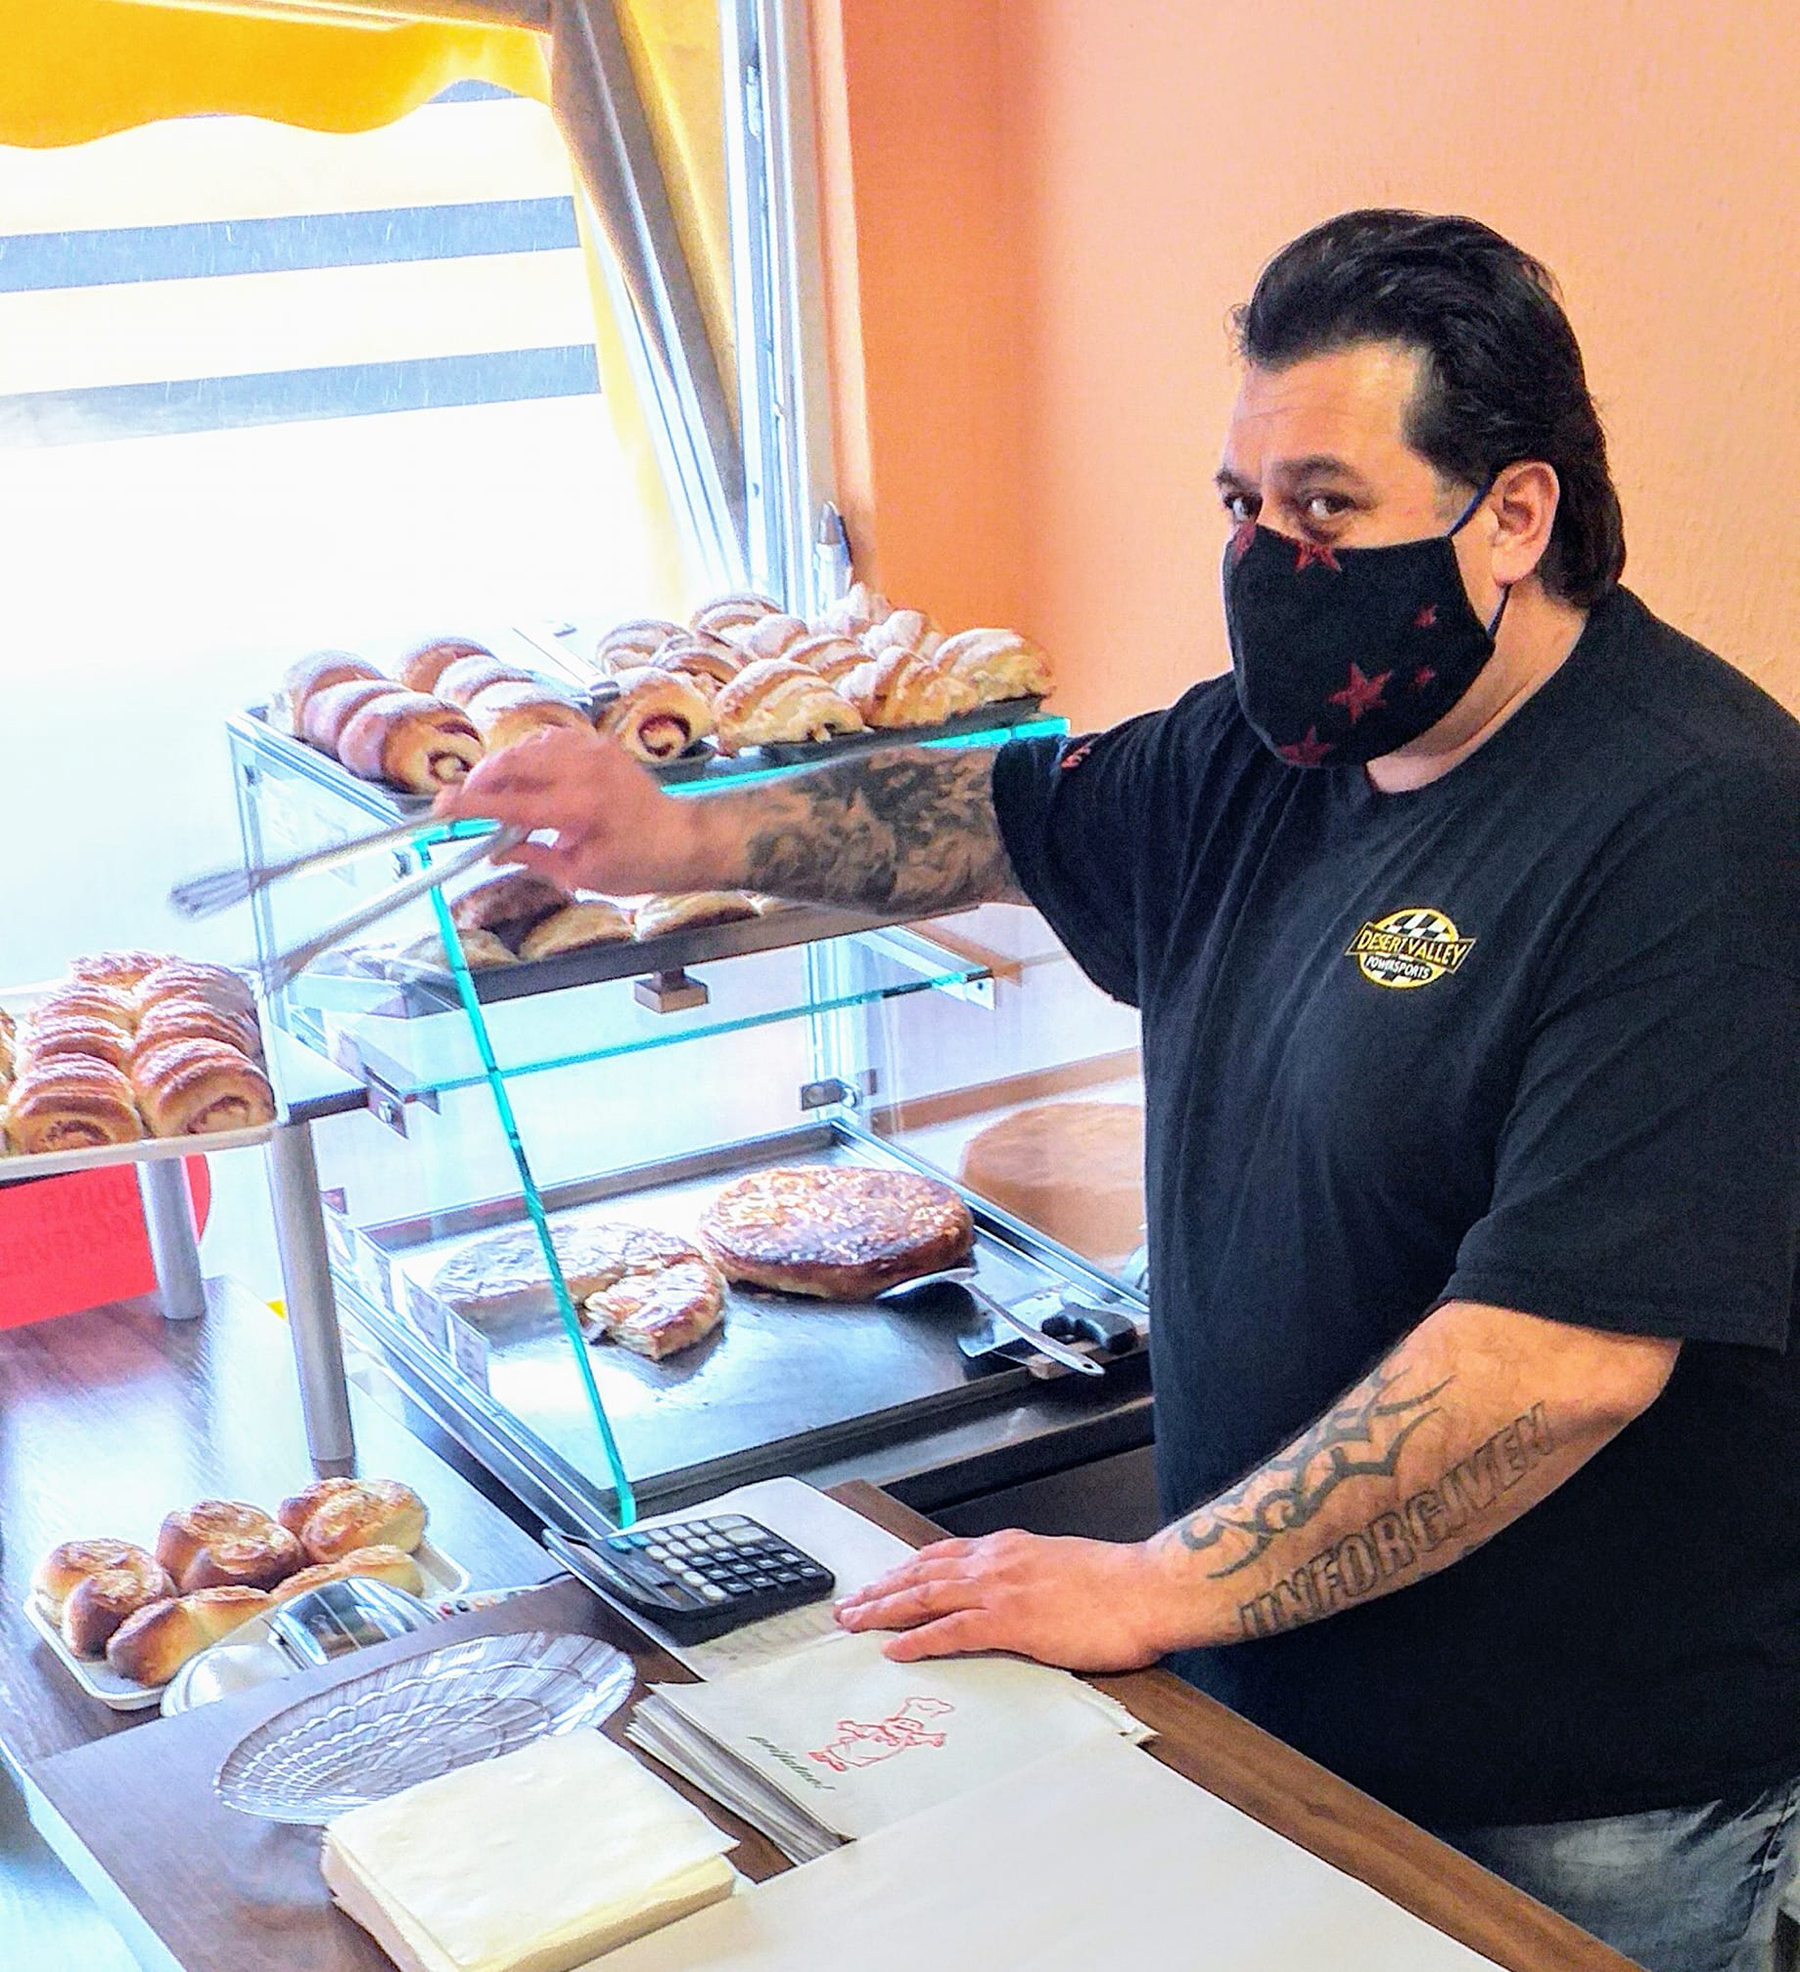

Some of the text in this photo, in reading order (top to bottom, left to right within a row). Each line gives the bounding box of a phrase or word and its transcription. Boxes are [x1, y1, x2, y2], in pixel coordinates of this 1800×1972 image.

[1357, 930, 1467, 966] DESERT VALLEY
[1366, 955, 1430, 979] POWERSPORTS
[1237, 1399, 1551, 1639] UNFORGIVEN
